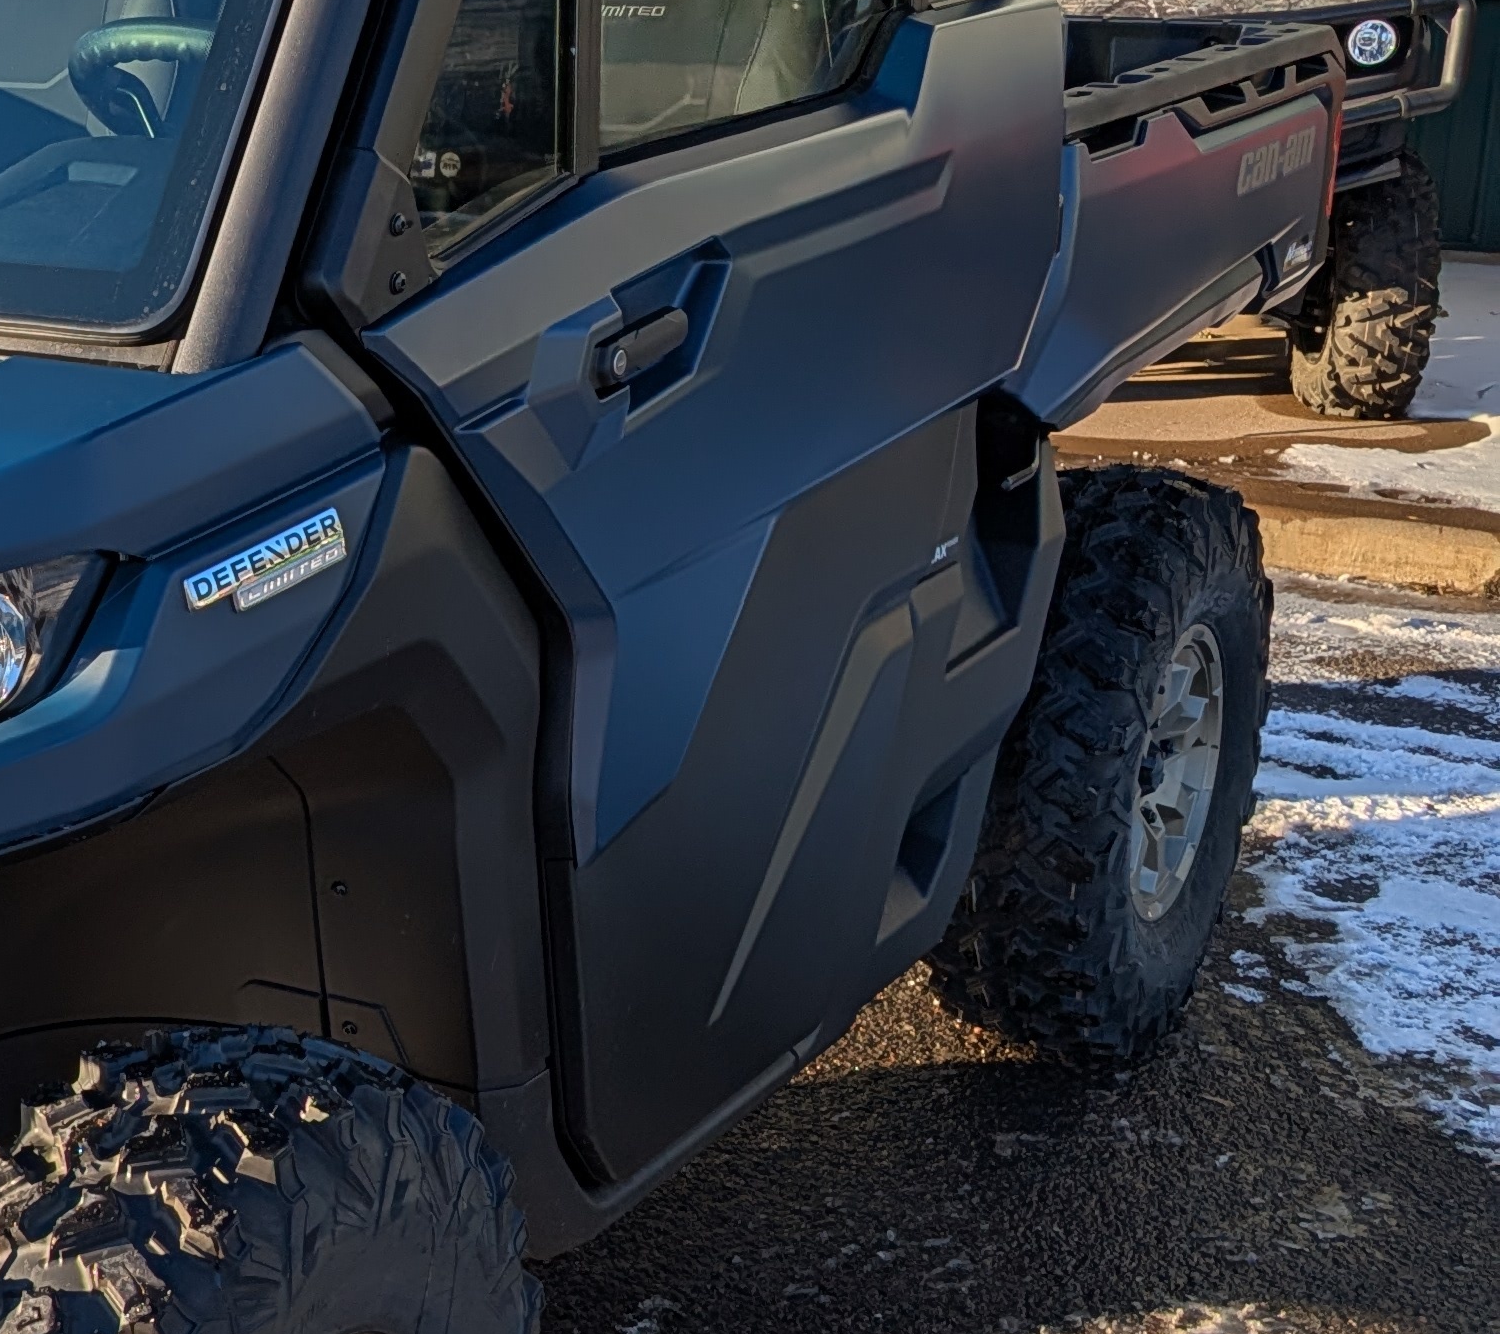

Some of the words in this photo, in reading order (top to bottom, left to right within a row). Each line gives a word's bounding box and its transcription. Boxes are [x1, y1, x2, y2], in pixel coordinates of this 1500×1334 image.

[601, 4, 666, 18] IMITED
[192, 514, 340, 600] DEFENDER
[248, 548, 338, 601] LIMITED
